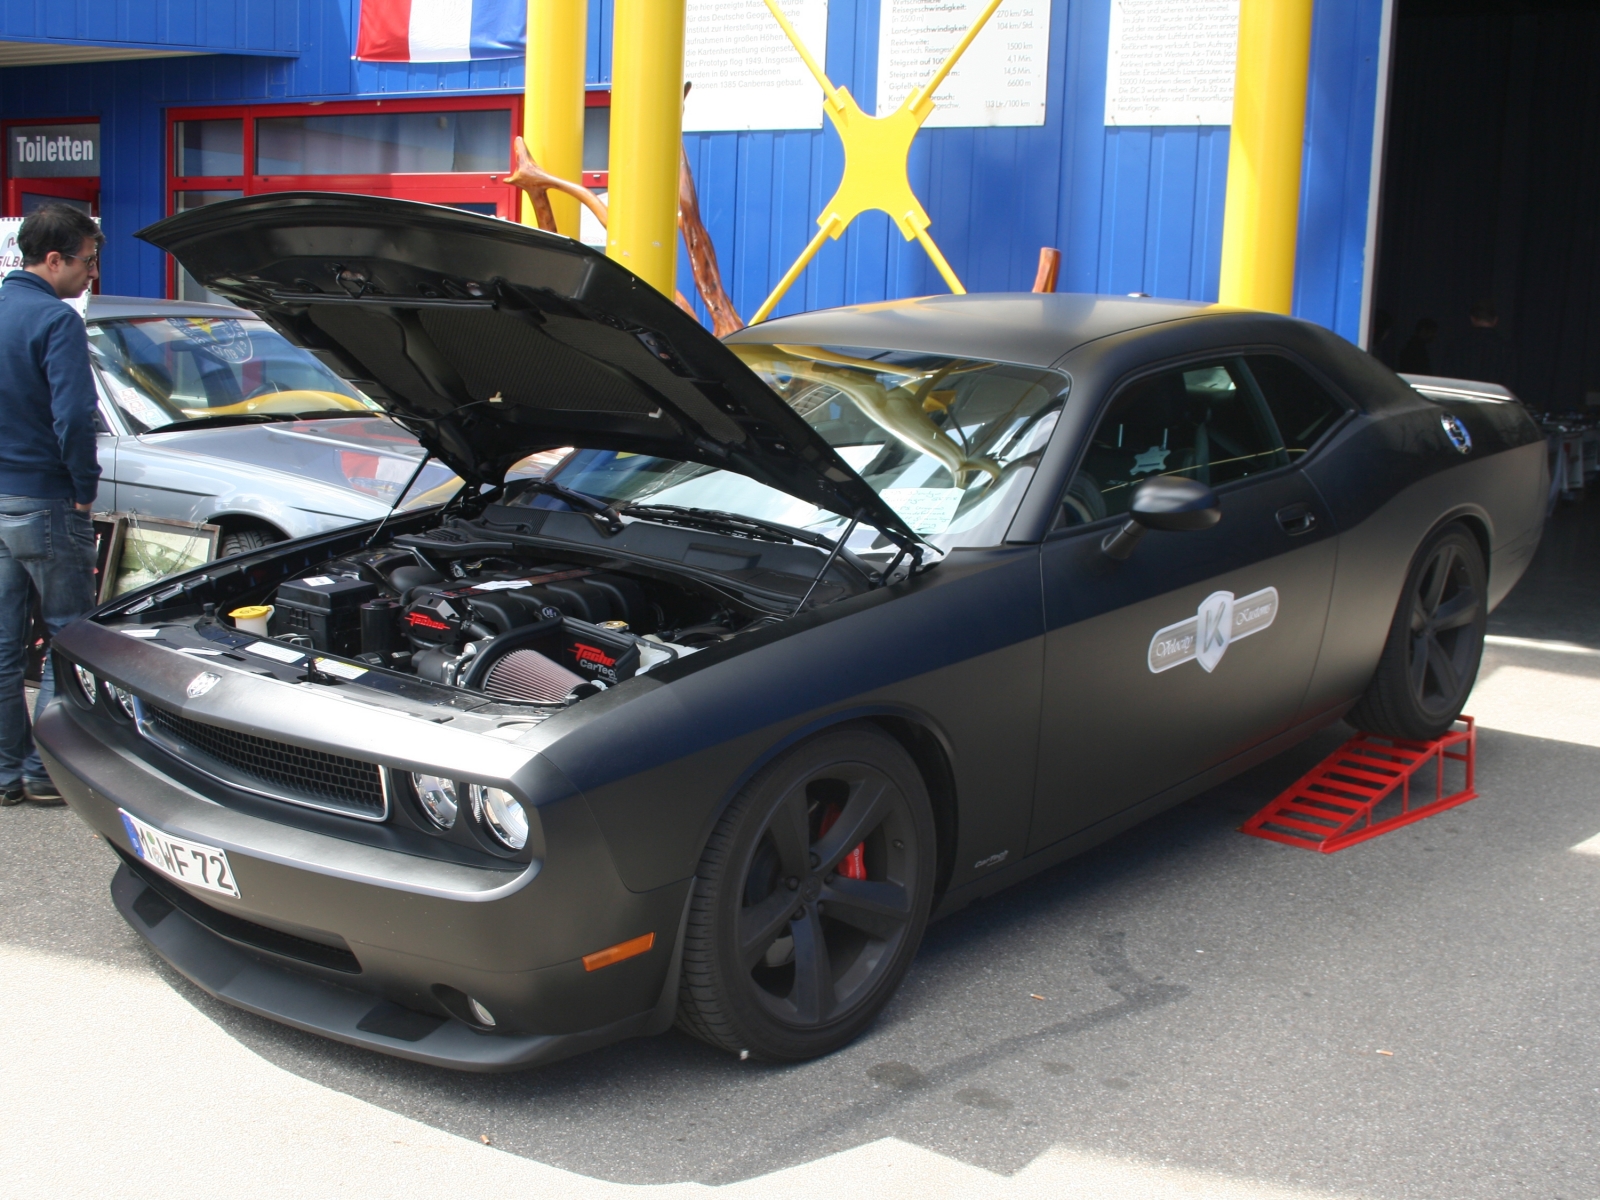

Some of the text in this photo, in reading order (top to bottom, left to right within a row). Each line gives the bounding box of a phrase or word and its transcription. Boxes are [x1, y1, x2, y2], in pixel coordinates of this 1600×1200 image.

[715, 2, 743, 11] gezeigte
[892, 4, 967, 14] Reisegeschwindigkeit:
[712, 13, 744, 21] Deutsche
[997, 10, 1009, 18] 270
[724, 24, 762, 32] Herstellung
[997, 22, 1008, 30] 104
[686, 37, 723, 45] aufnahmen
[734, 35, 758, 44] großen
[891, 38, 929, 46] Reichweite:
[698, 46, 758, 55] Kartenherstellung
[730, 58, 742, 66] flog
[890, 59, 918, 67] Steigzeit
[889, 71, 917, 79] Steigzeit
[1007, 79, 1024, 87] 6600
[17, 136, 93, 162] Toiletten
[140, 827, 233, 890] M WF 72
